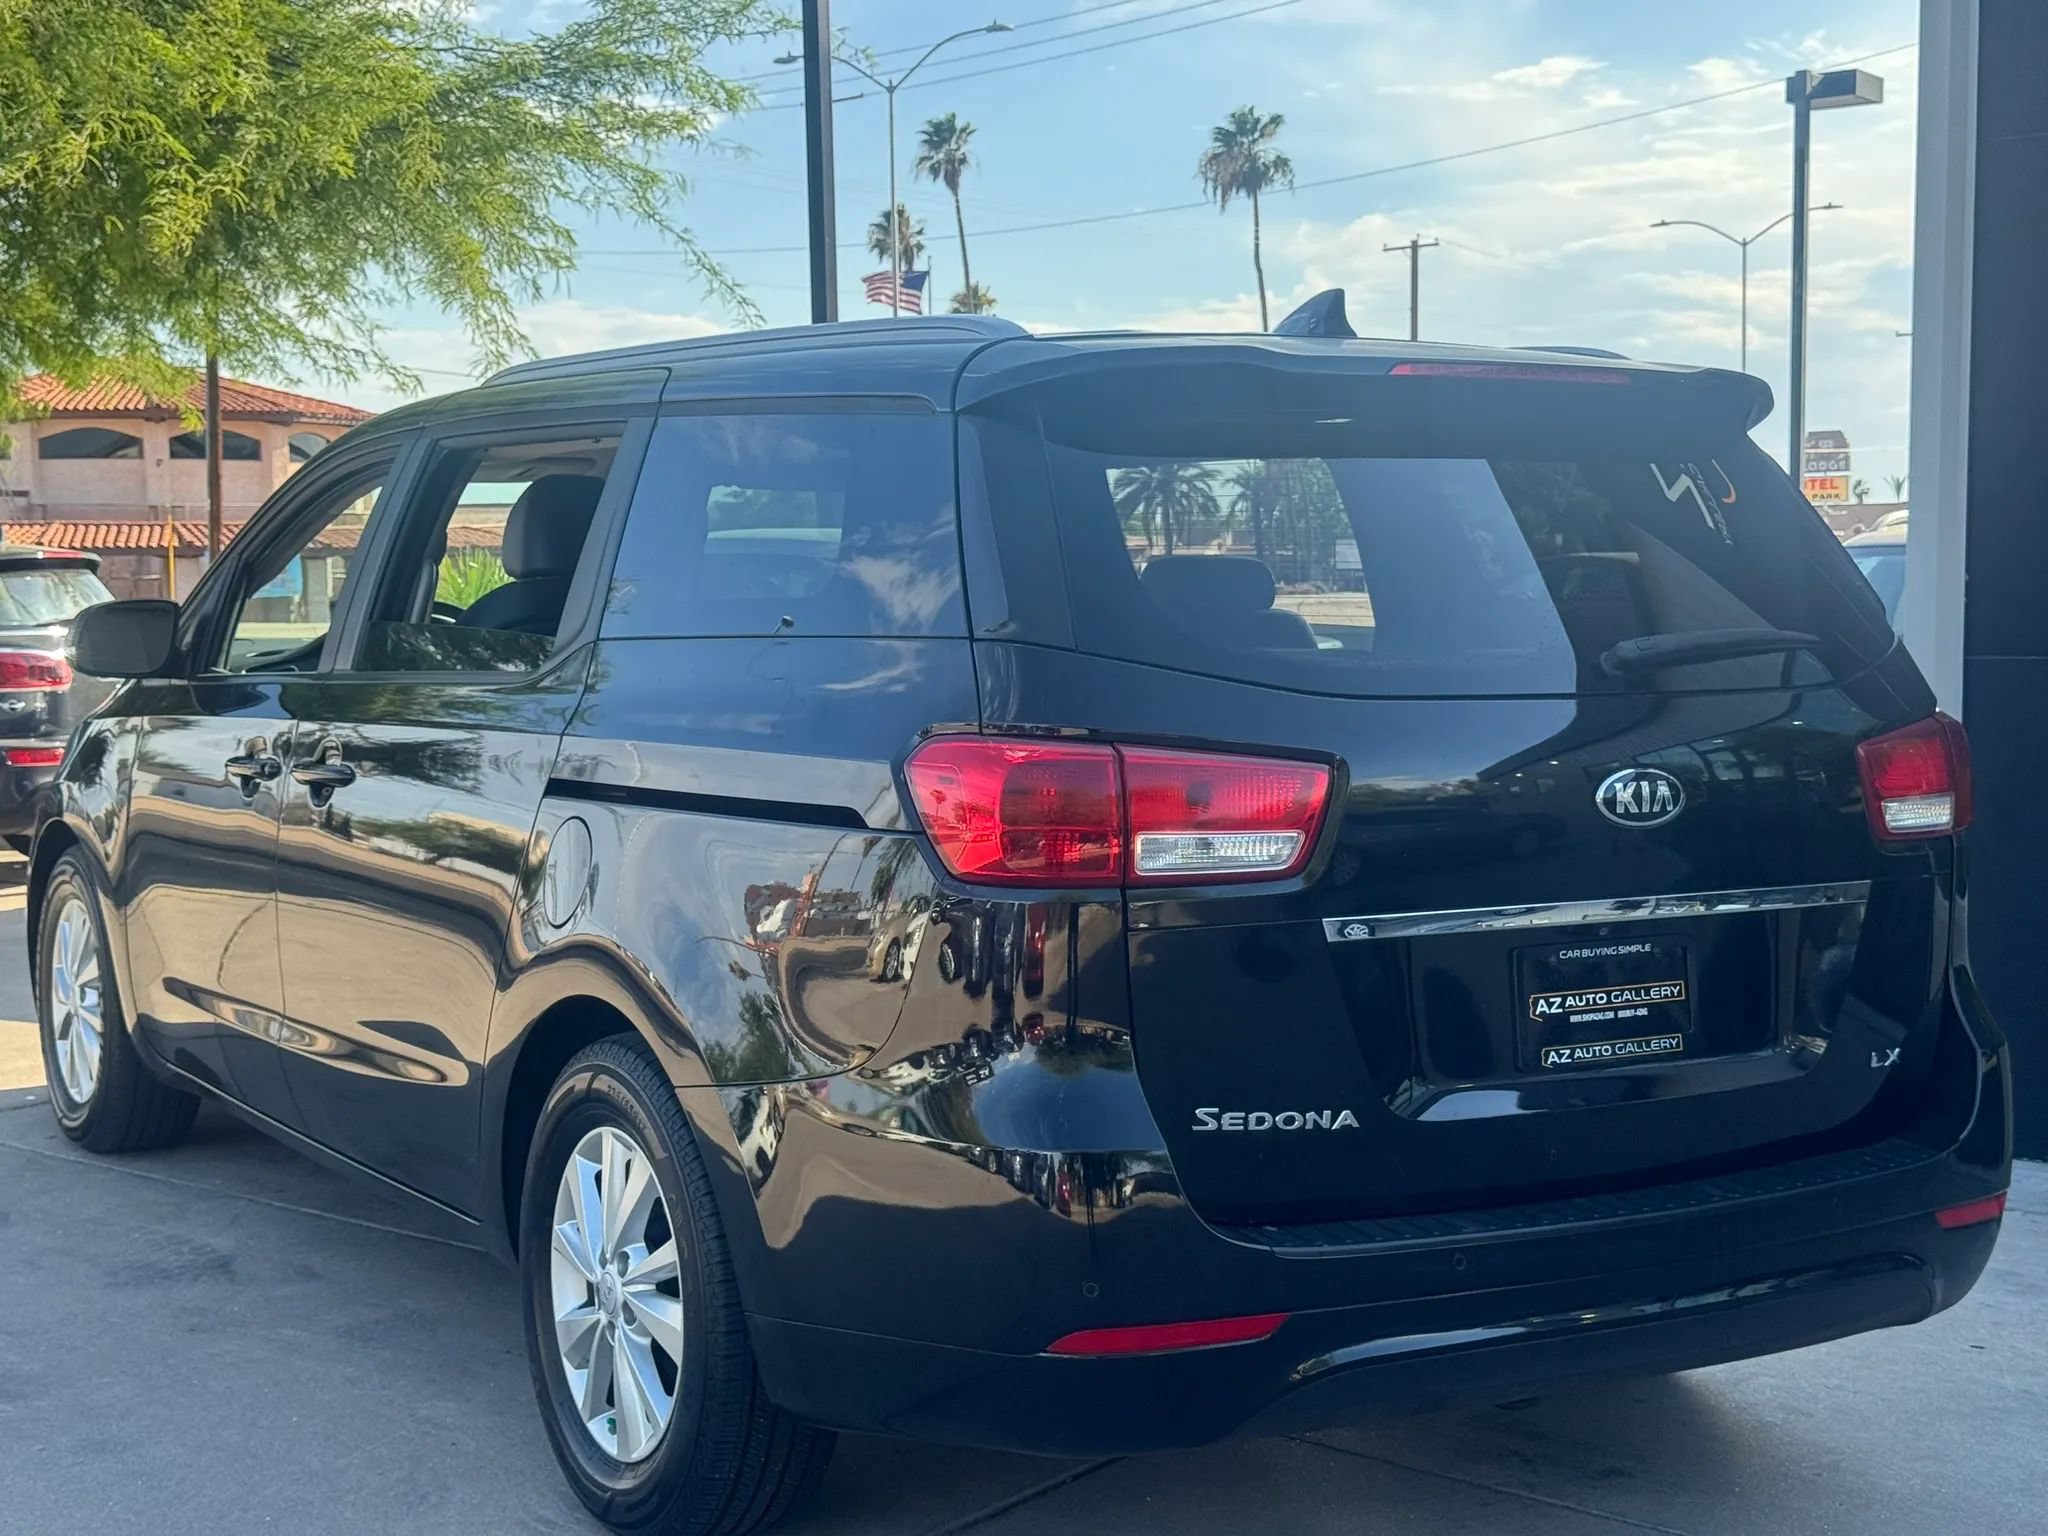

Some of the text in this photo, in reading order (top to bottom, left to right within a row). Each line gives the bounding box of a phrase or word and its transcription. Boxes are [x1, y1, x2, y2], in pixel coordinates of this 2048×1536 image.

[1613, 780, 1674, 813] KIA
[1560, 943, 1651, 959] CAR BUYING SIMPLE
[1535, 985, 1680, 1015] AZ AUTO GALLERY
[1547, 1037, 1679, 1064] AZ AUTO GALLERY
[1870, 1047, 1901, 1068] LX
[1191, 1107, 1361, 1131] SEDONA
